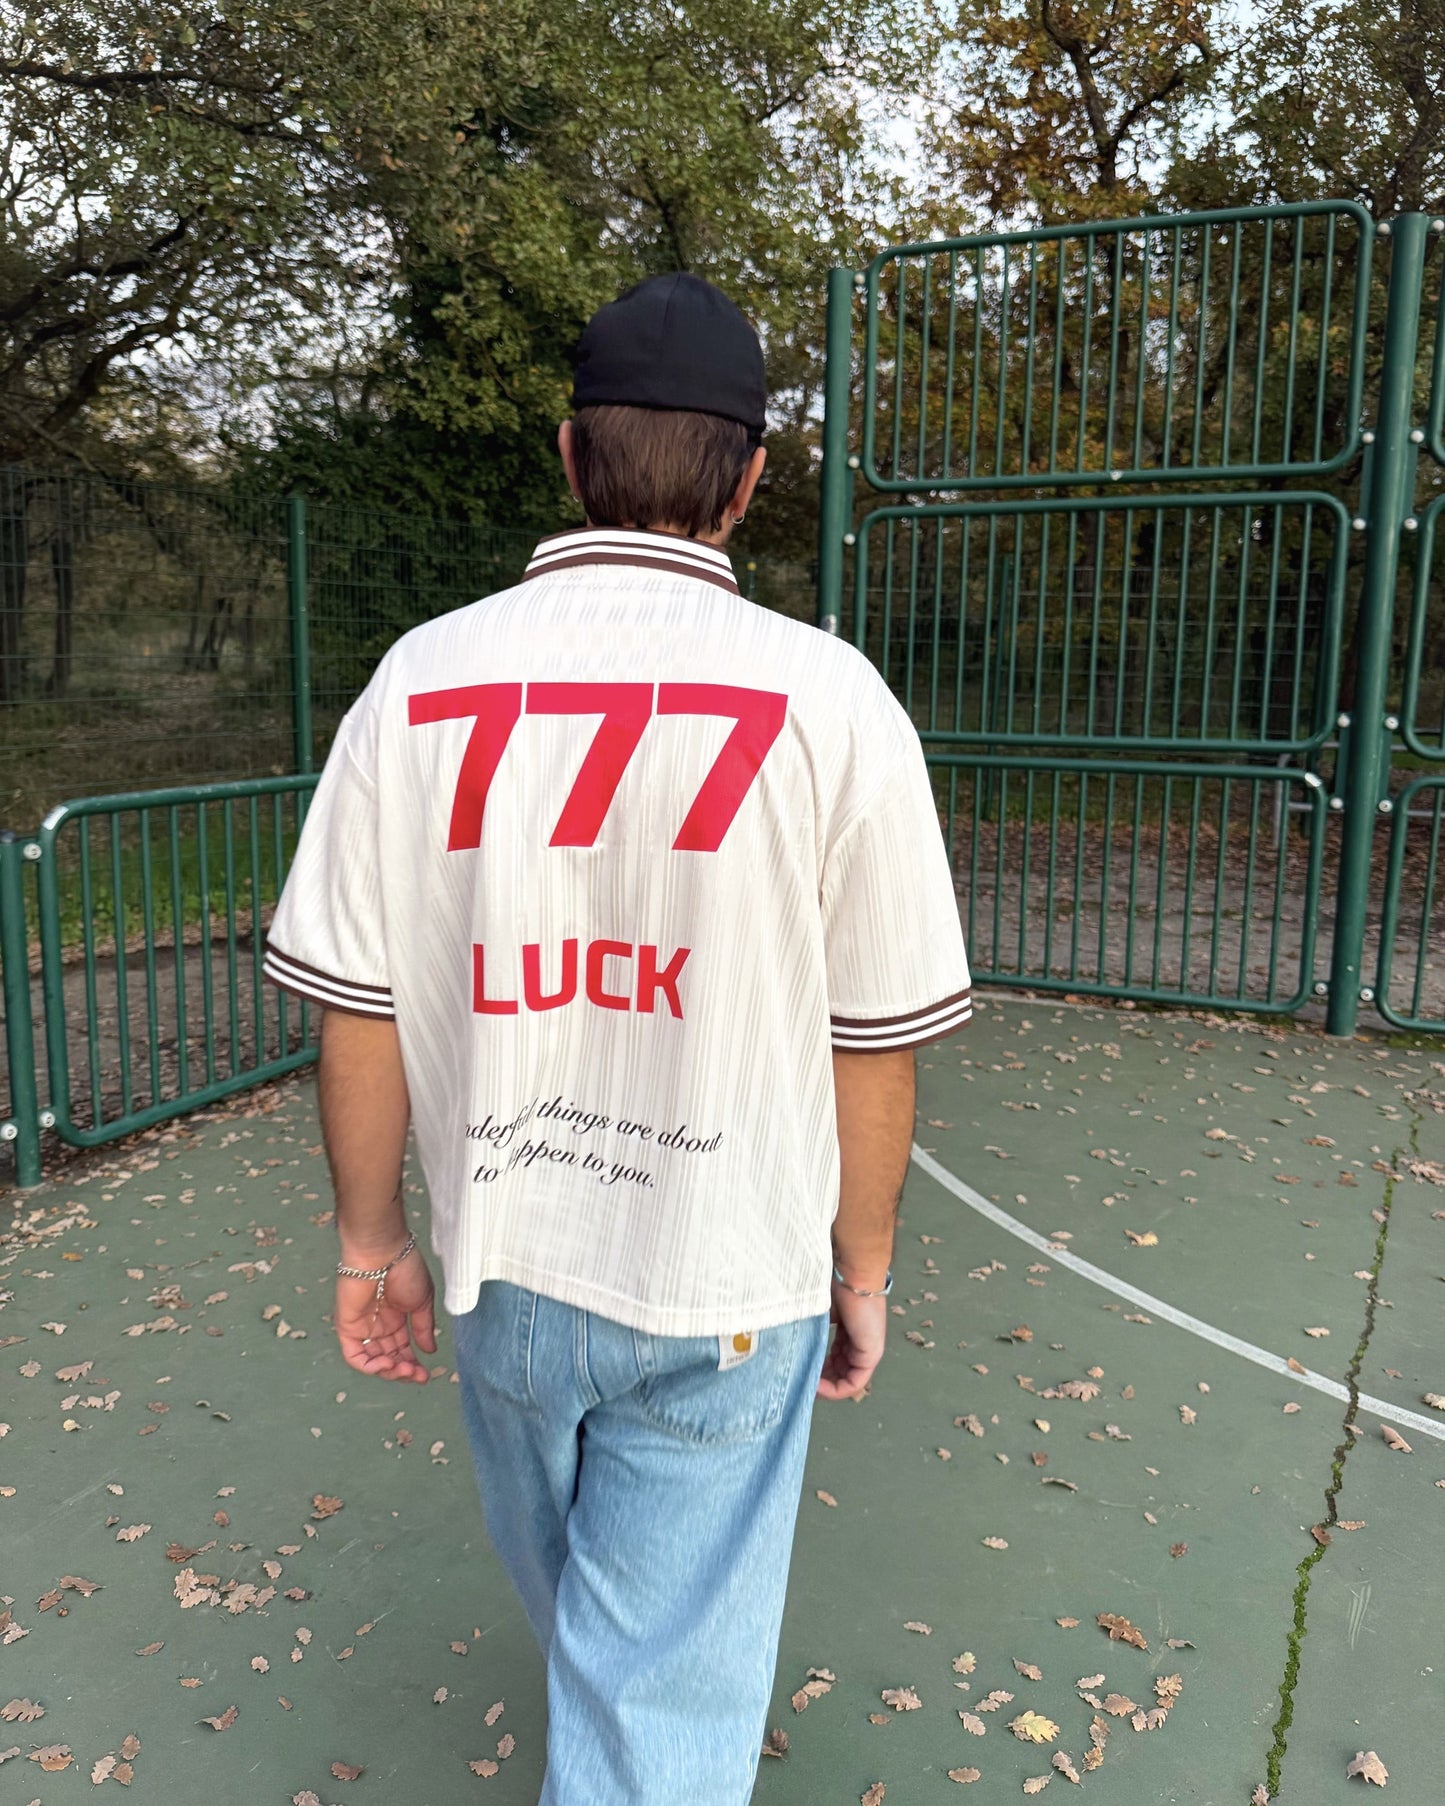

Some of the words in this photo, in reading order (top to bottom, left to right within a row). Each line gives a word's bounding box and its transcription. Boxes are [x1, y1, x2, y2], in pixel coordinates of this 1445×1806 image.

[409, 682, 788, 852] 777
[473, 939, 691, 1019] LUCK
[536, 1095, 614, 1134] things
[617, 1119, 655, 1140] are
[658, 1125, 723, 1153] about
[473, 1163, 502, 1184] to
[504, 1140, 579, 1175] ppen
[582, 1152, 607, 1171] to
[600, 1163, 655, 1188] you.
